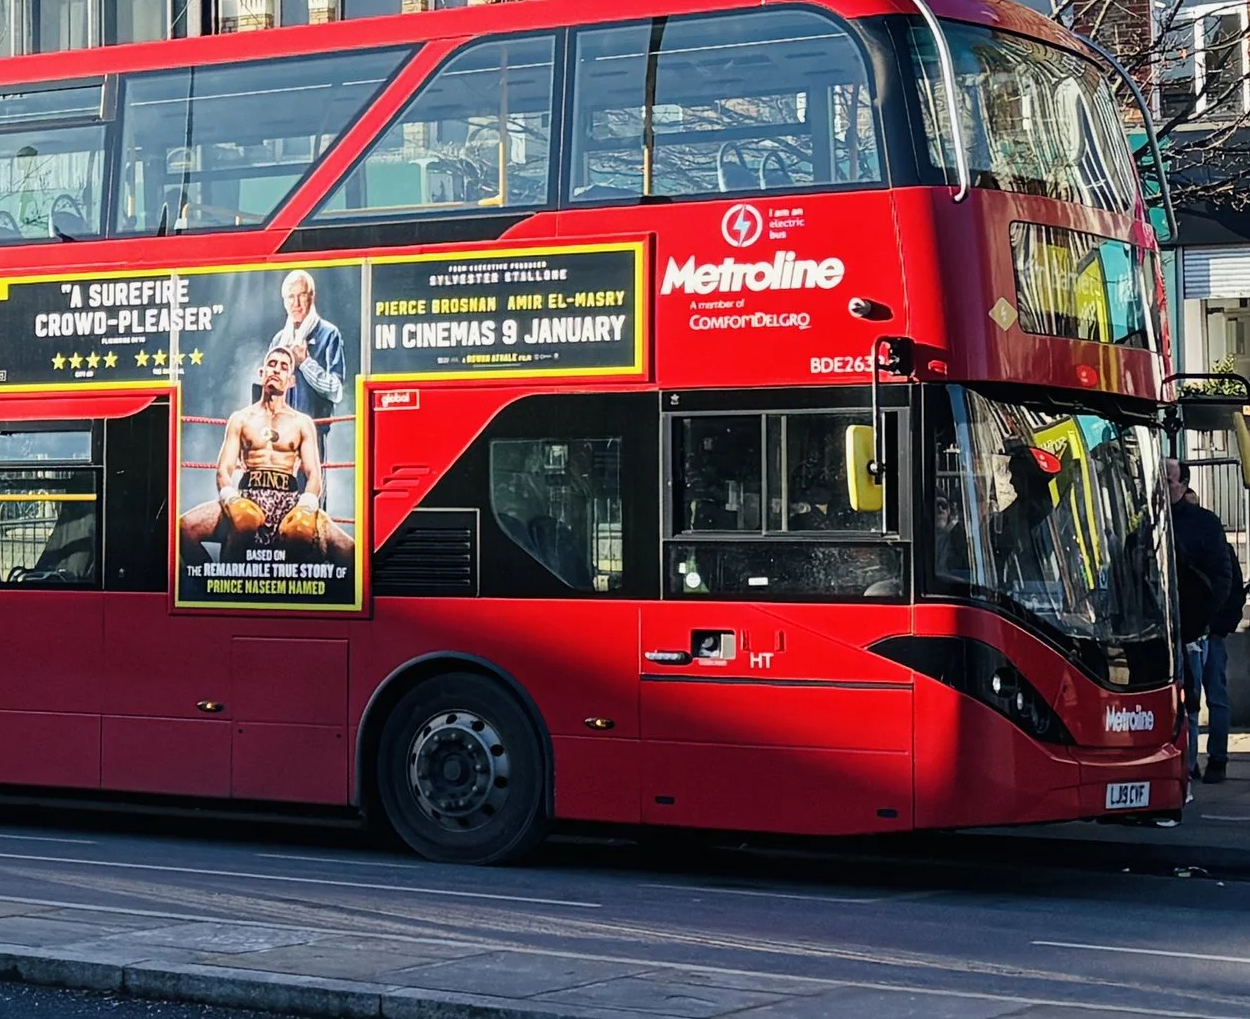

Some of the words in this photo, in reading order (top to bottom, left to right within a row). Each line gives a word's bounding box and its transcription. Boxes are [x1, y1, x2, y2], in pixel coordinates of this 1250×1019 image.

[769, 208, 773, 217] I
[774, 209, 790, 217] am
[791, 208, 803, 216] an
[769, 218, 805, 228] electric
[769, 230, 786, 239] bus
[429, 272, 499, 286] SYLVESTER
[504, 268, 567, 282] STALLONE
[660, 250, 845, 295] Metroline
[61, 283, 82, 308] "A
[89, 279, 190, 308] SUREFIRE
[375, 300, 426, 316] PIERCE
[431, 296, 497, 314] BROSNAN
[507, 294, 543, 310] AMIR
[548, 290, 625, 308] EL-MASRY
[690, 301, 697, 309] A
[698, 300, 736, 309] member
[737, 299, 745, 308] of
[35, 304, 224, 337] CROWD-PLEASER"
[375, 324, 396, 349] IN
[402, 320, 496, 348] CINEMAS
[502, 319, 518, 345] 9
[523, 314, 626, 343] JANUARY
[248, 470, 290, 491] PRINCE
[246, 549, 271, 561] BASED
[273, 549, 286, 562] ON
[187, 565, 202, 577] THE
[203, 562, 270, 578] REMARKABLE
[272, 563, 300, 578] TRUE
[300, 563, 334, 579] STORY
[335, 567, 347, 579] OF
[207, 579, 243, 594] PRINCE
[245, 580, 287, 594] NASEEM
[288, 580, 325, 595] HAMED
[750, 652, 774, 669] HT
[1105, 704, 1154, 732] Metroline
